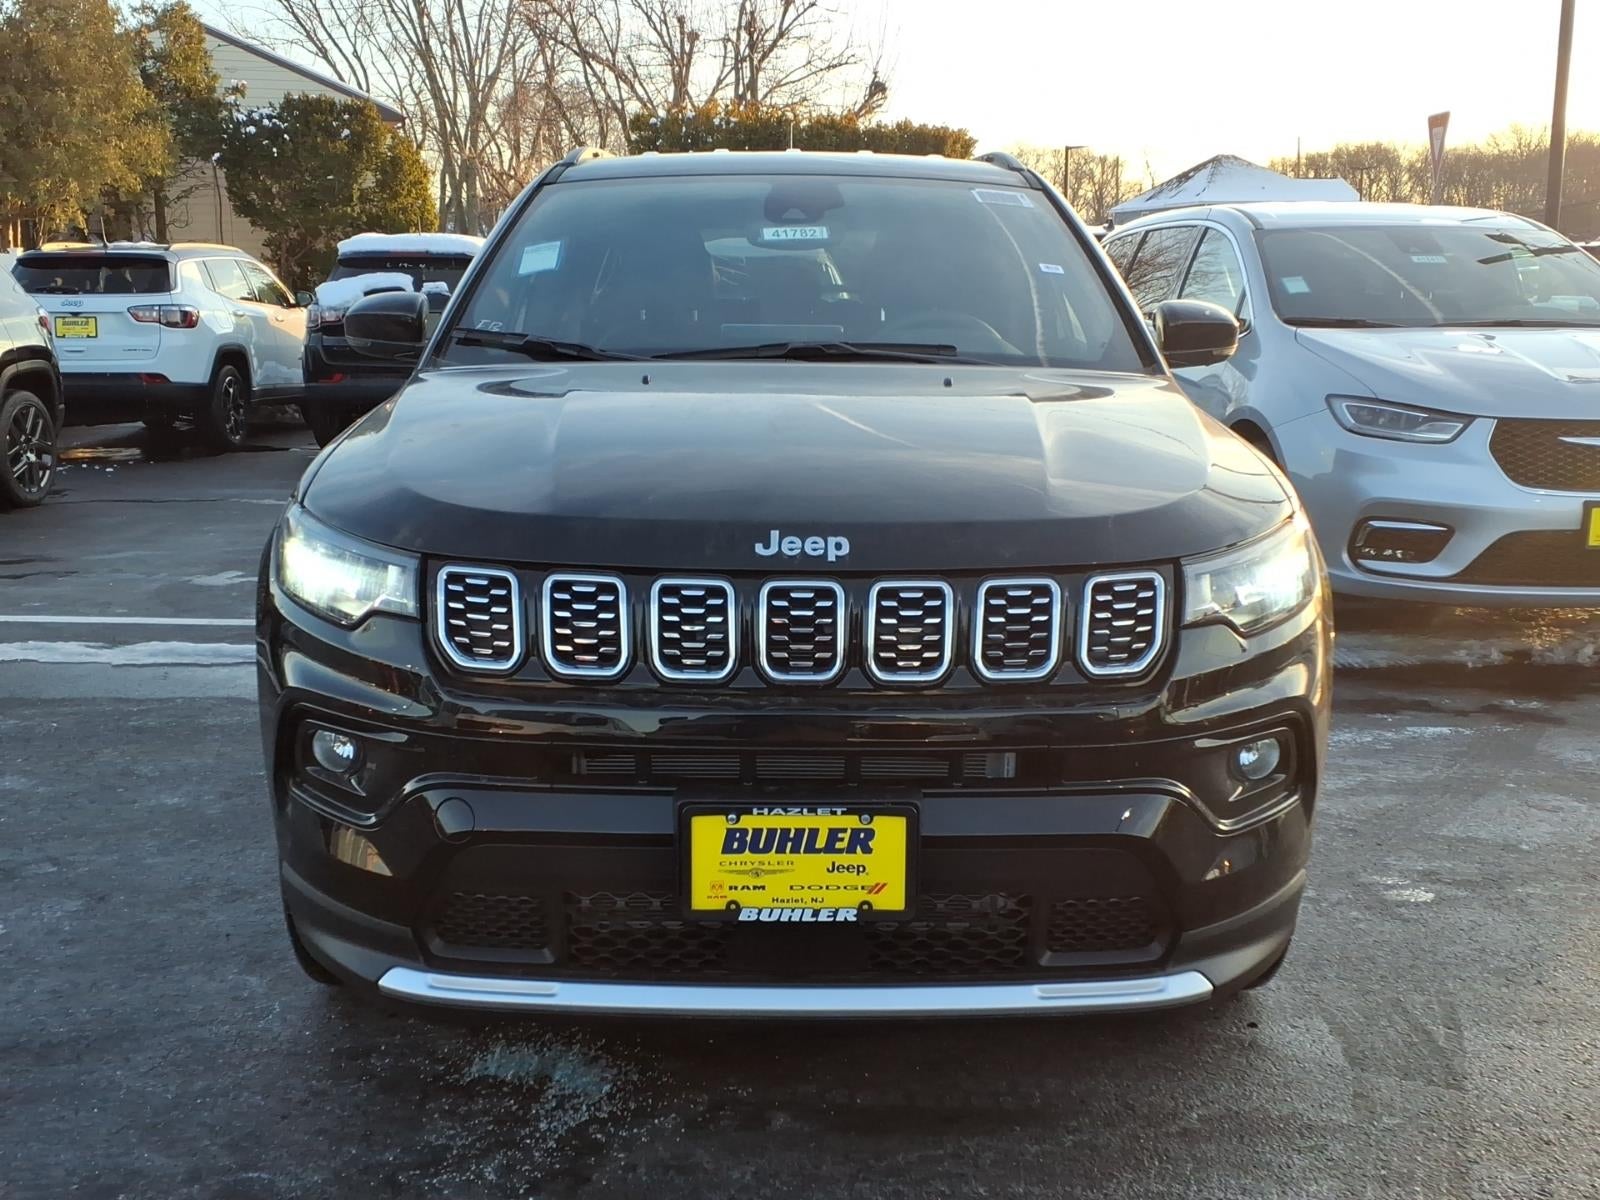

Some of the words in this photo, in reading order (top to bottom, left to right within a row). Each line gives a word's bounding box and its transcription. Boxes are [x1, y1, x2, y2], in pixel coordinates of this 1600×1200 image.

[772, 228, 817, 239] 41782
[754, 529, 850, 562] Jeep
[752, 807, 848, 816] HAZLET
[721, 827, 876, 855] BUHLER
[826, 861, 867, 876] Jeep
[771, 896, 808, 905] Hazlet,
[810, 896, 825, 904] NJ
[738, 907, 858, 922] BUHLER
